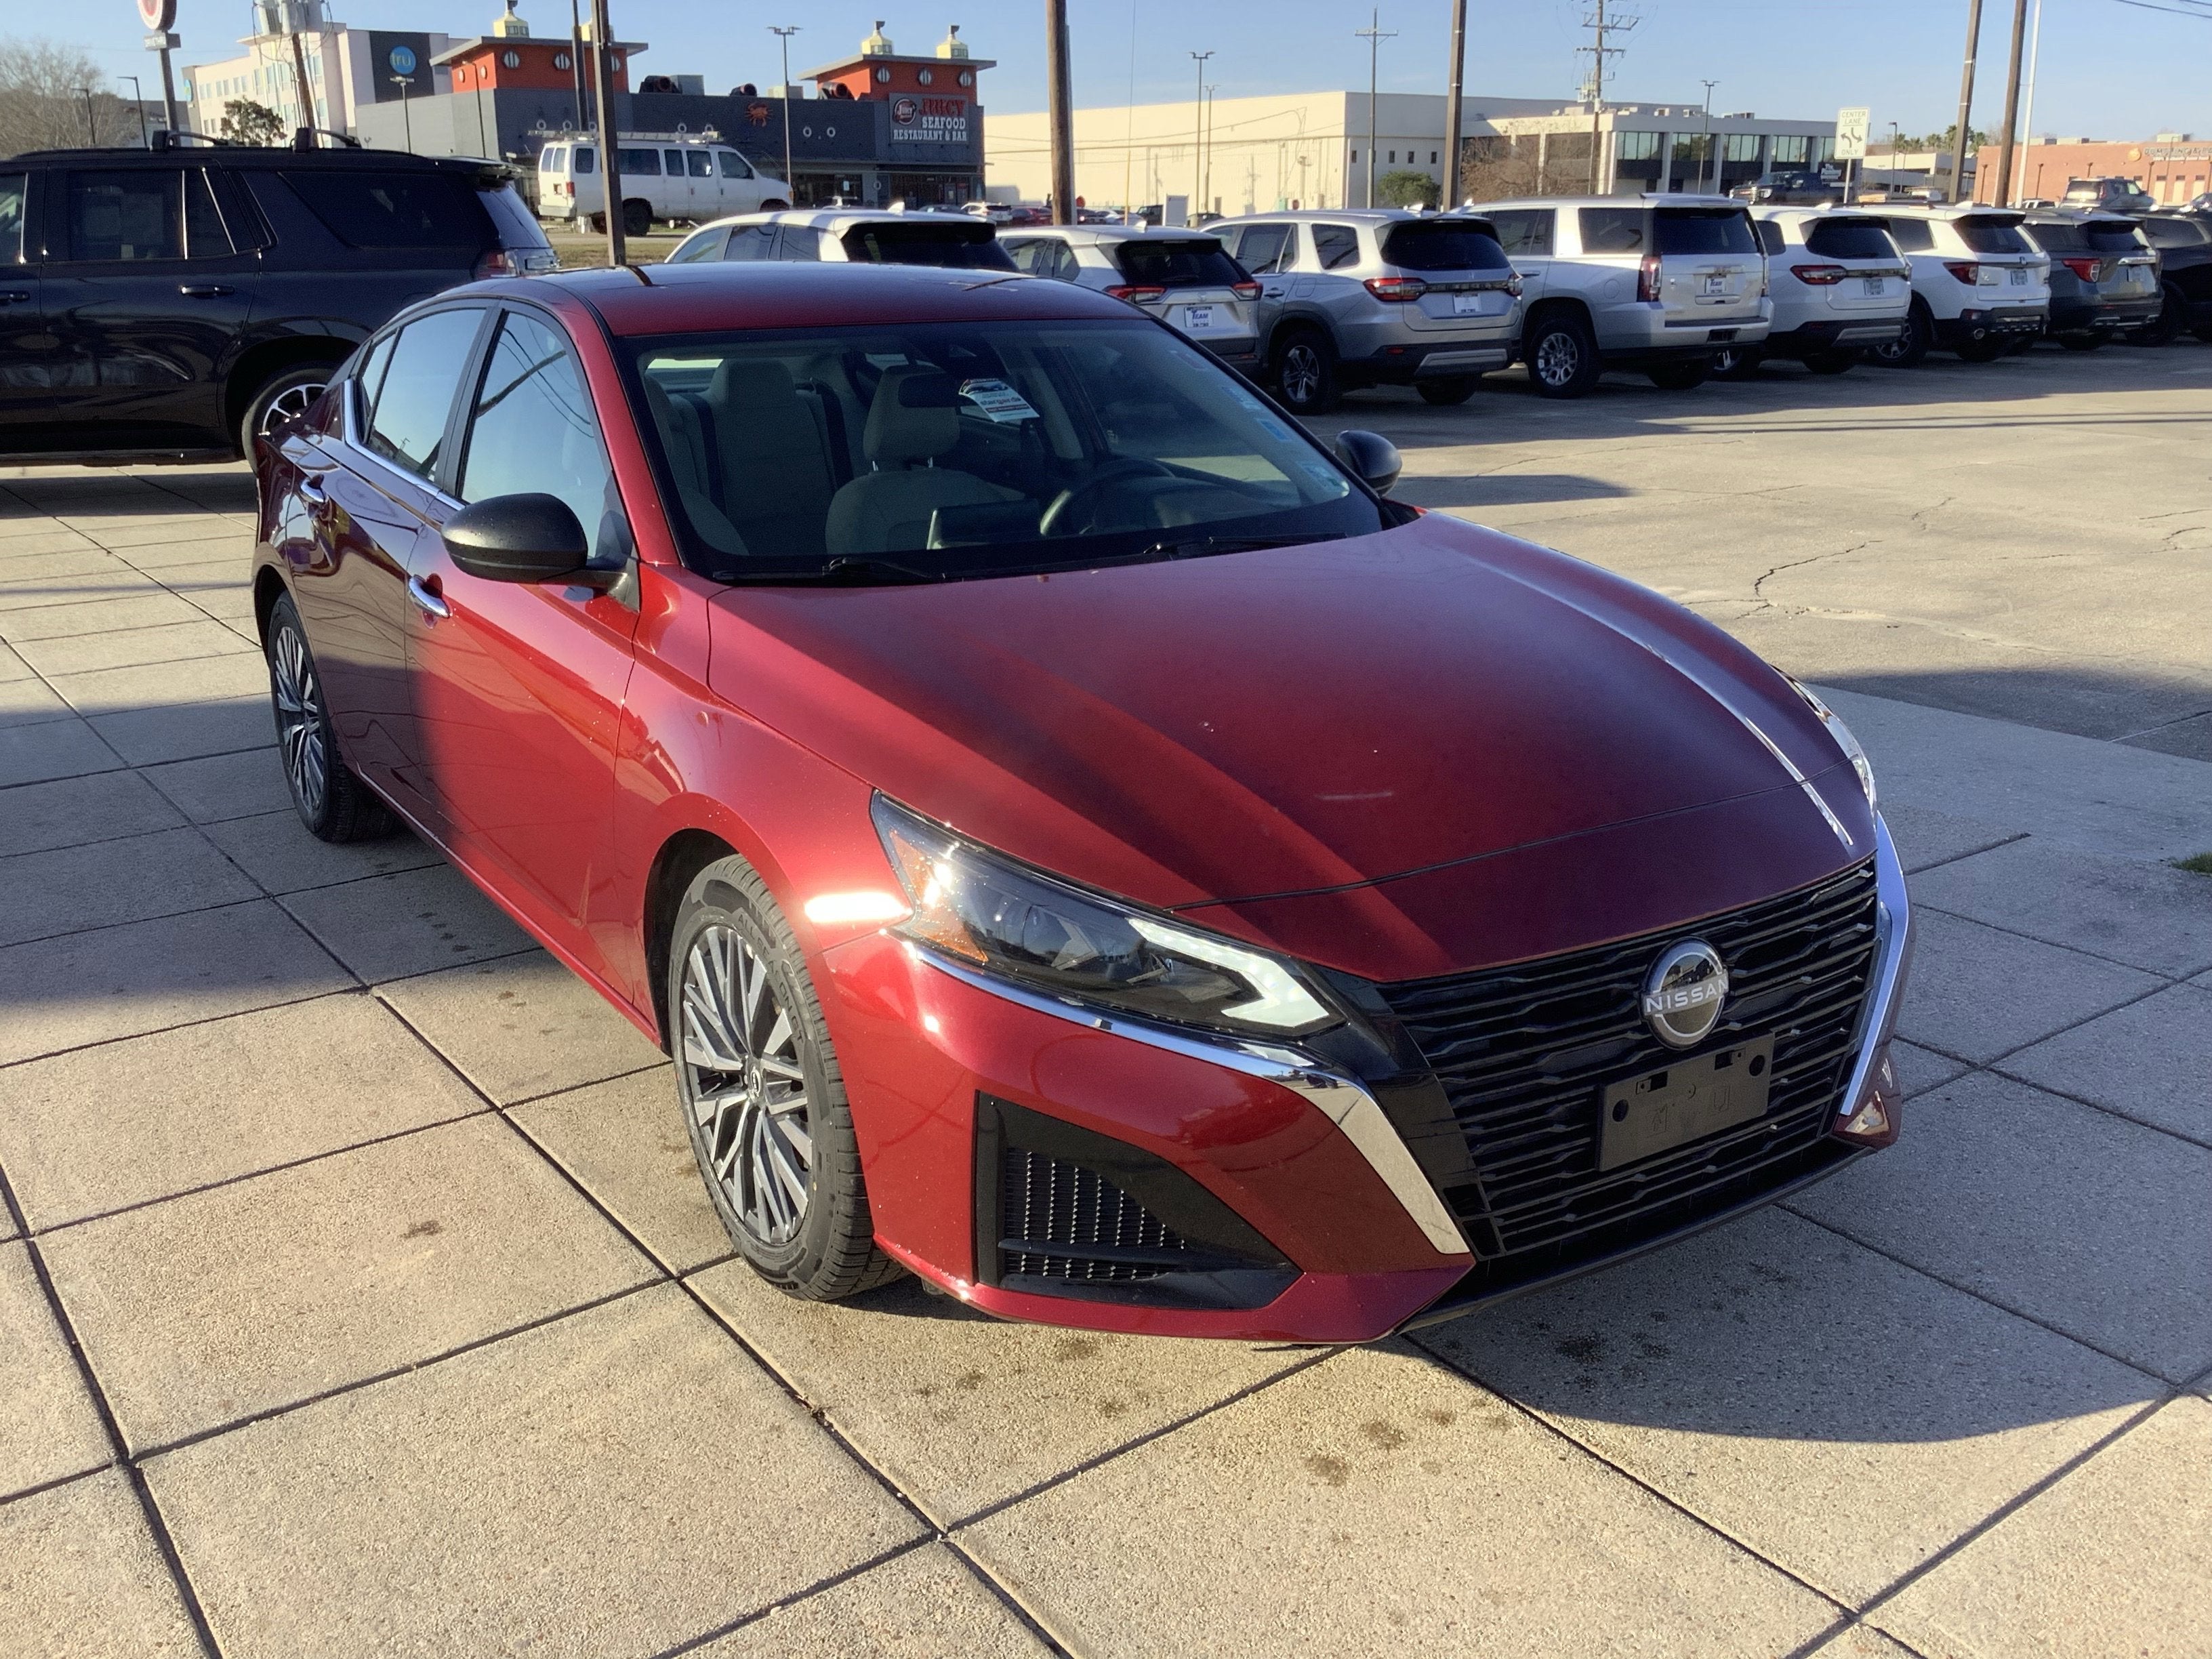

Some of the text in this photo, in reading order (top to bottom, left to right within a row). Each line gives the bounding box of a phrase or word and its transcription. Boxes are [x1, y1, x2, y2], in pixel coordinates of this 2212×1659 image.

[390, 52, 411, 66] tru
[919, 98, 965, 116] JUICY
[922, 117, 966, 129] SEAFOOD
[894, 129, 967, 141] RESTAURANT & BAR
[738, 914, 756, 939] ALL
[757, 937, 793, 1012] SEASON
[1645, 976, 1727, 1012] NISSAN
